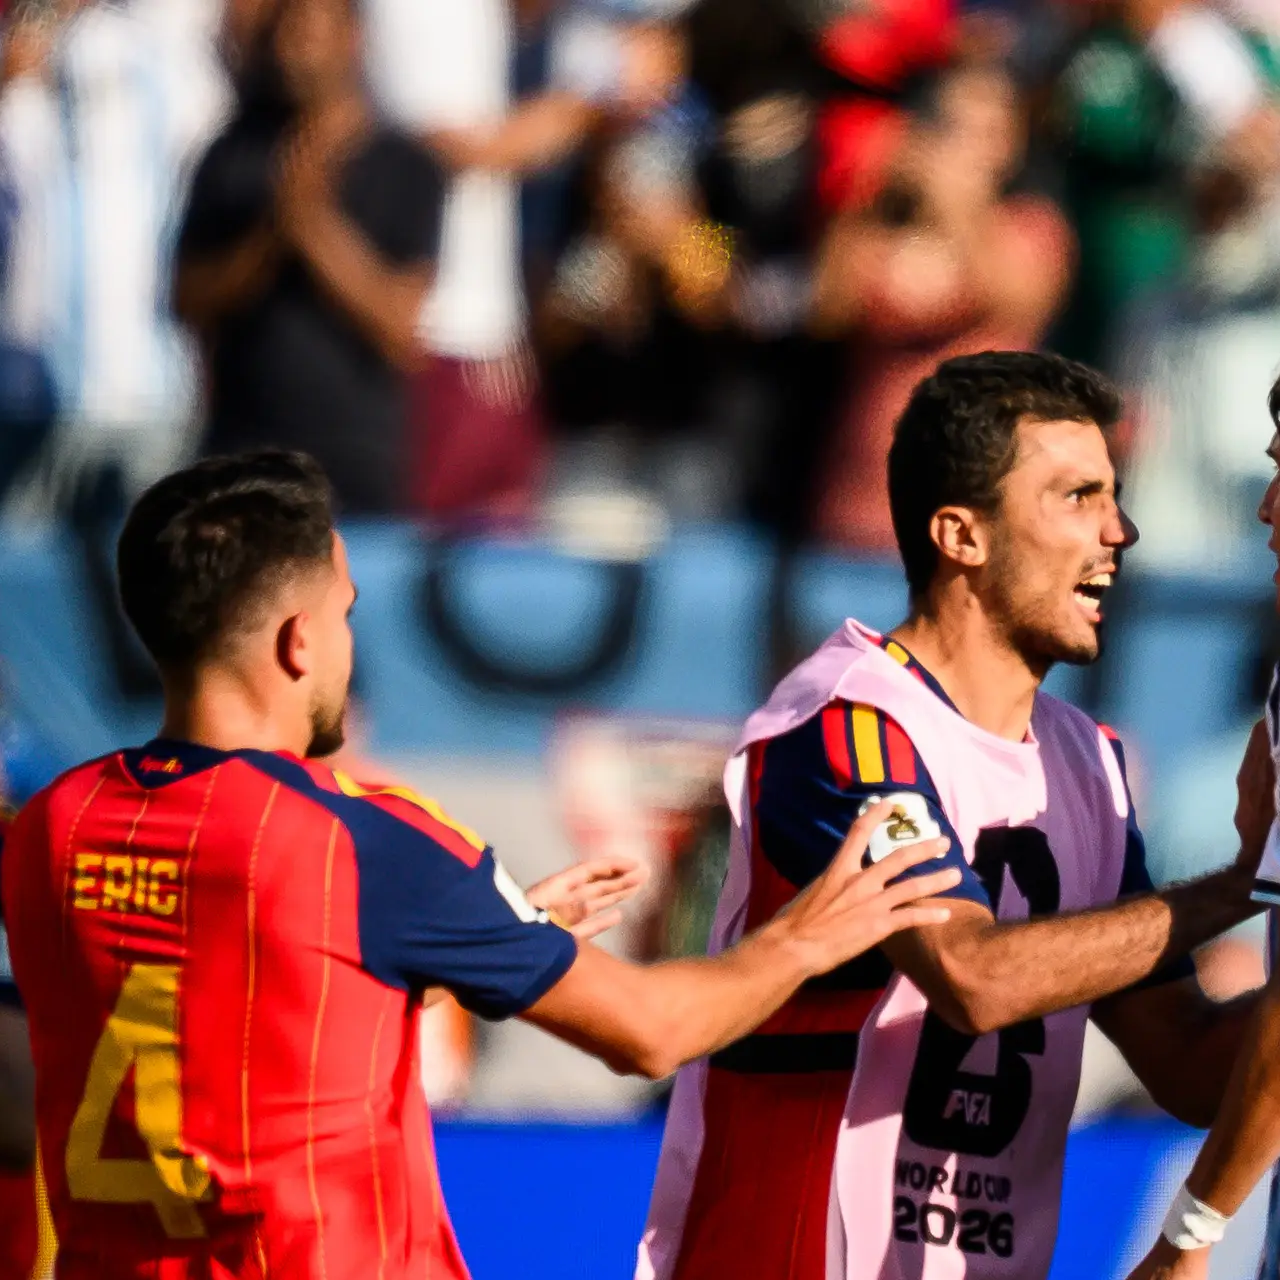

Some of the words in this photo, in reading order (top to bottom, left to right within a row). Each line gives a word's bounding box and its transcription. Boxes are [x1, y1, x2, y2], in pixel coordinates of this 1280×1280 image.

[73, 852, 179, 916] ERIC
[64, 962, 214, 1241] 4
[941, 1087, 993, 1127] FIFA
[893, 1195, 1015, 1259] 2026
